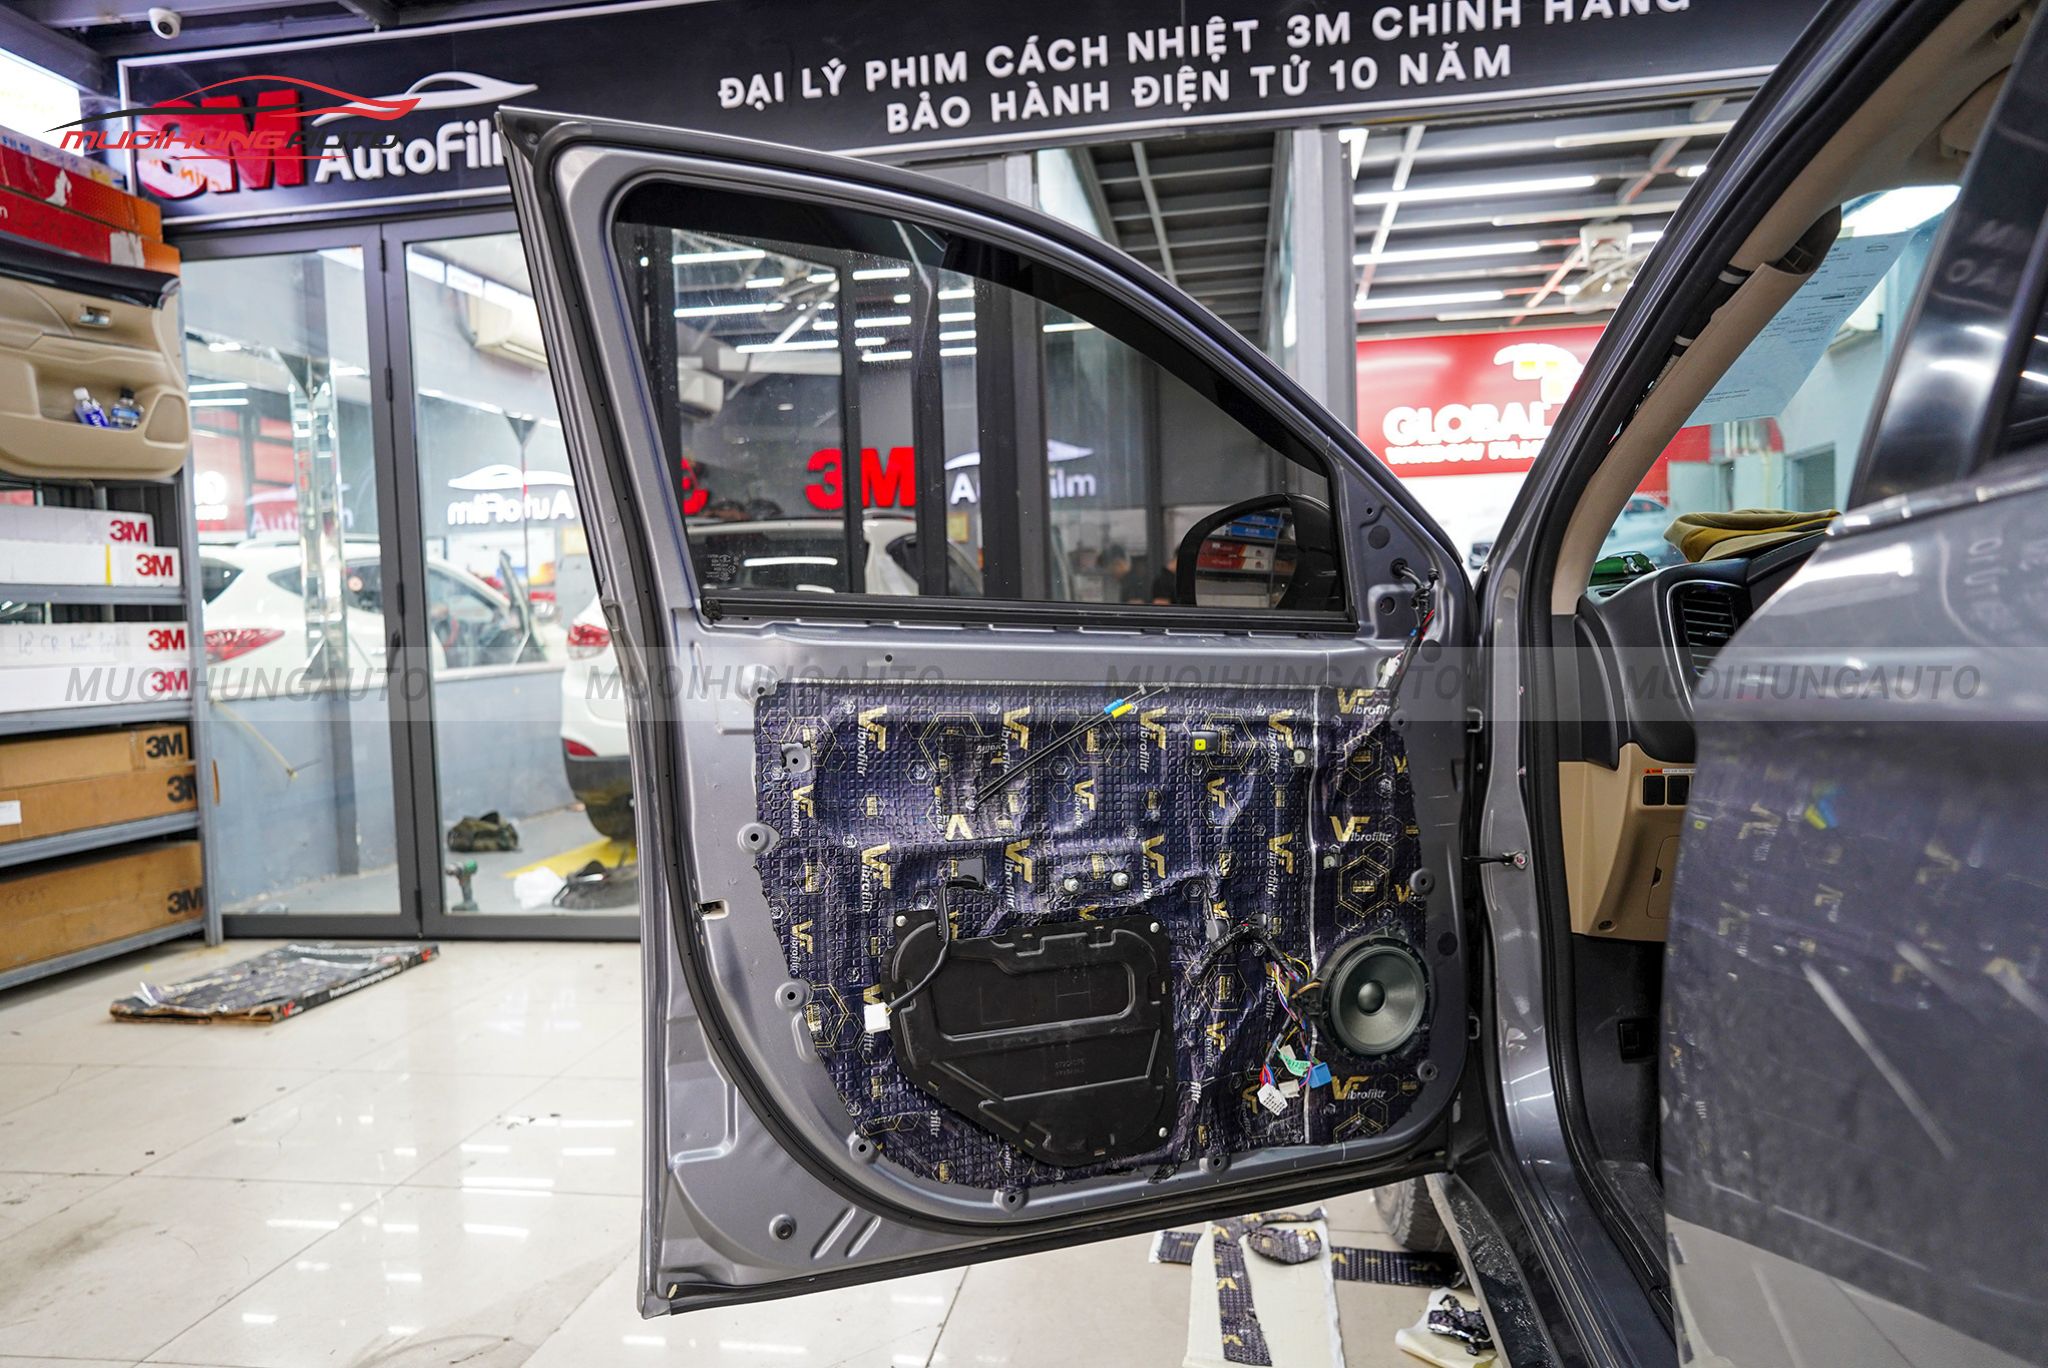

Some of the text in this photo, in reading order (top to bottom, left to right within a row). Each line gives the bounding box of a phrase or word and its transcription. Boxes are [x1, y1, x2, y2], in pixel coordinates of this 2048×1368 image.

[717, 71, 784, 111] ĐẠI
[802, 57, 847, 98] LÝ
[865, 50, 967, 92] PHIM
[985, 34, 1108, 78] CÁCH
[1127, 15, 1259, 64] NHIỆT
[1287, 11, 1350, 48] 3M
[887, 41, 1511, 134] BẢO HÀNH ĐIỆN TỬ 10 NĂM
[805, 446, 916, 510] 3M
[110, 519, 148, 544] 3M
[136, 554, 174, 577] 3M
[148, 628, 186, 651] 3M
[152, 669, 189, 692] 3M
[145, 732, 184, 759] 3M
